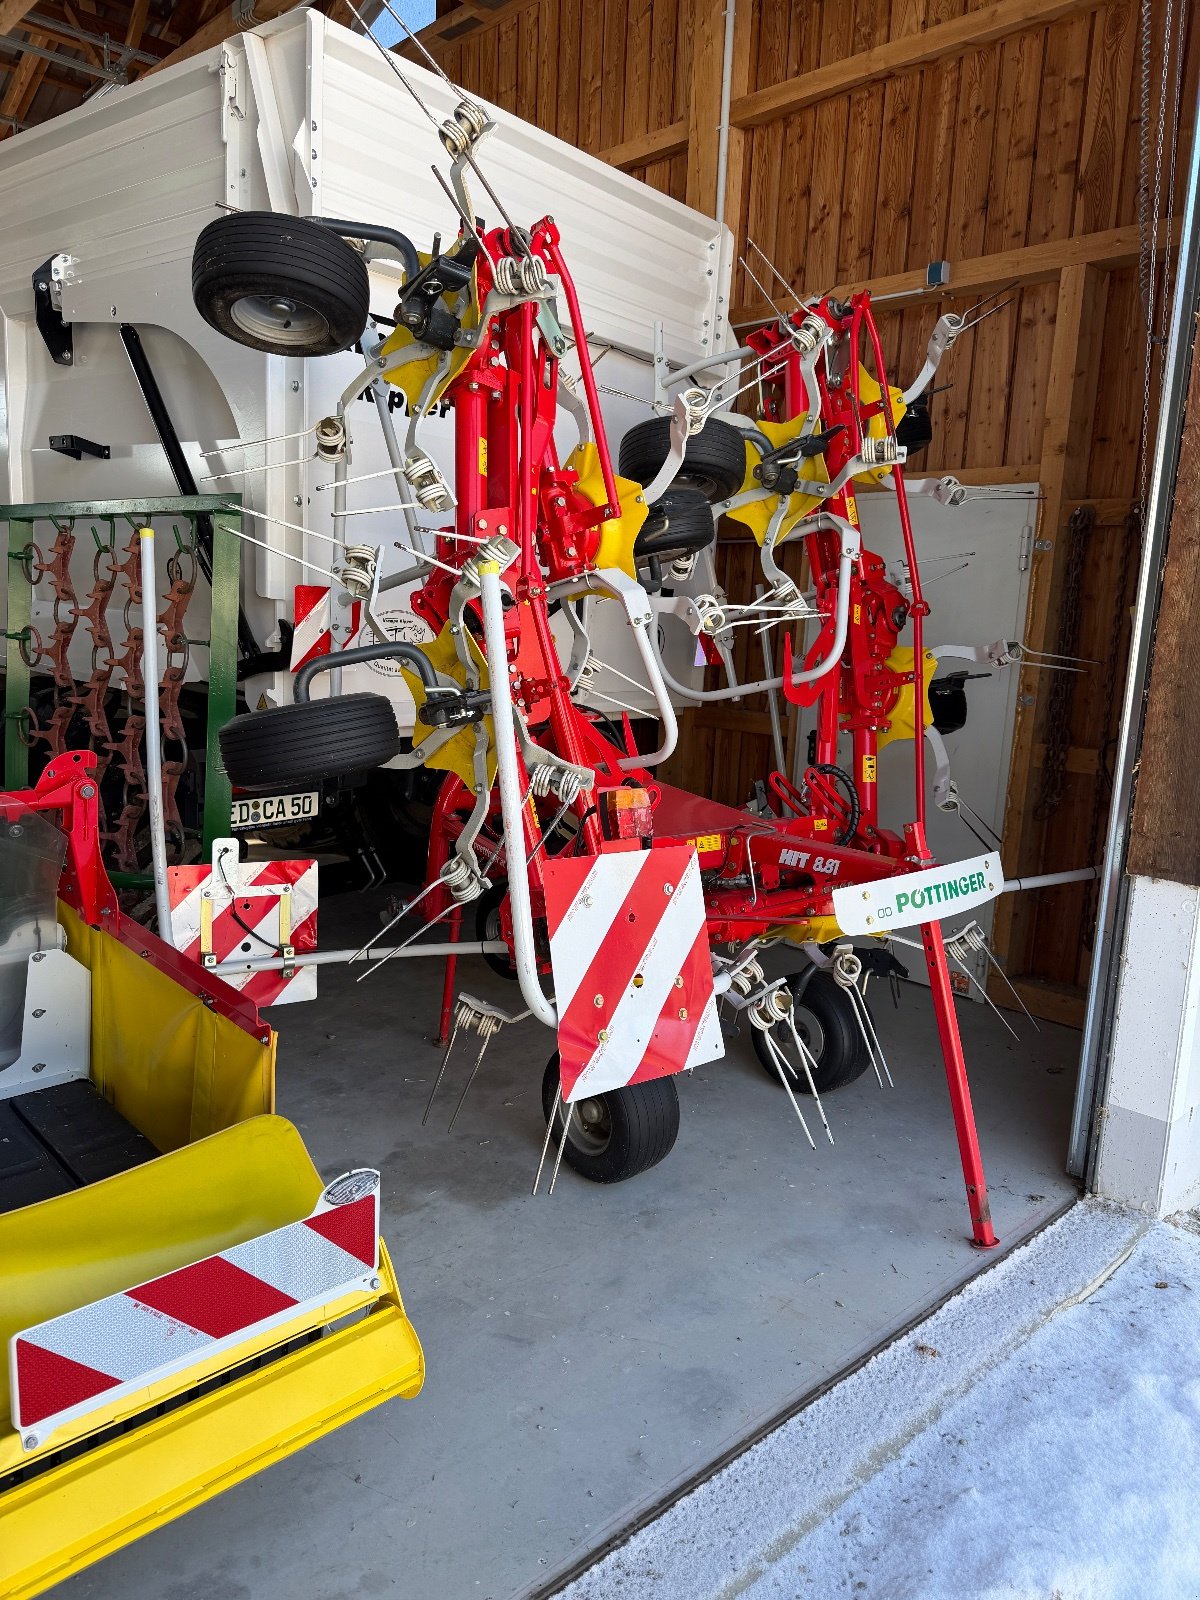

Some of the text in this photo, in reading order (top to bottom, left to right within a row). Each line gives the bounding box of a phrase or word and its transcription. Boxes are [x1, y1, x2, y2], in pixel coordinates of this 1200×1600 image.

[263, 798, 286, 820] CA
[291, 795, 312, 816] 50
[778, 848, 811, 869] HIT
